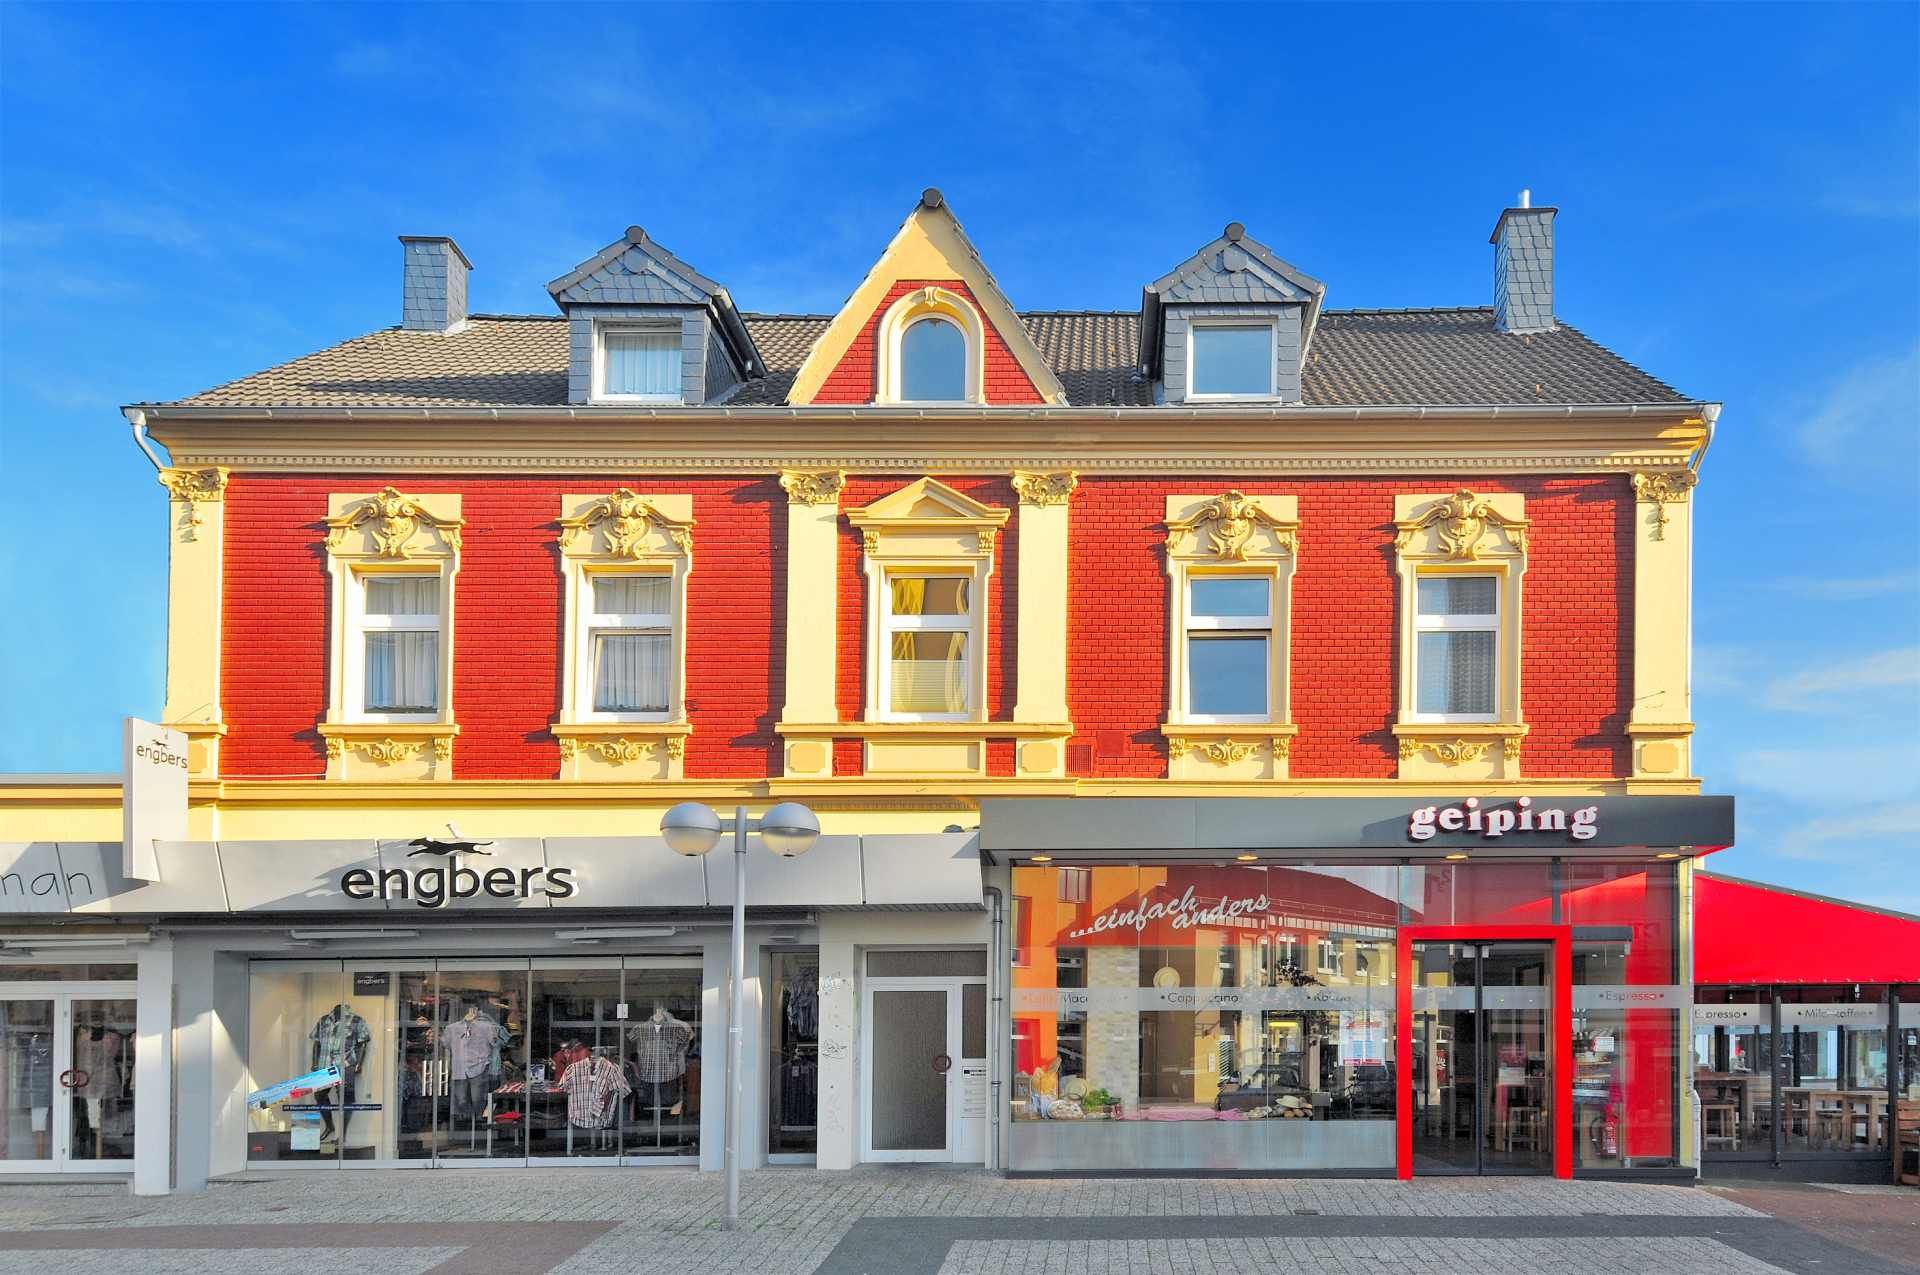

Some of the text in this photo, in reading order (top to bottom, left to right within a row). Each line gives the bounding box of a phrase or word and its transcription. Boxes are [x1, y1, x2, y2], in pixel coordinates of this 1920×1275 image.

[136, 745, 188, 769] engbers
[1410, 796, 1599, 840] geiping
[341, 855, 576, 908] engbers
[1171, 893, 1271, 930] anders
[1694, 1008, 1741, 1020] Epresso
